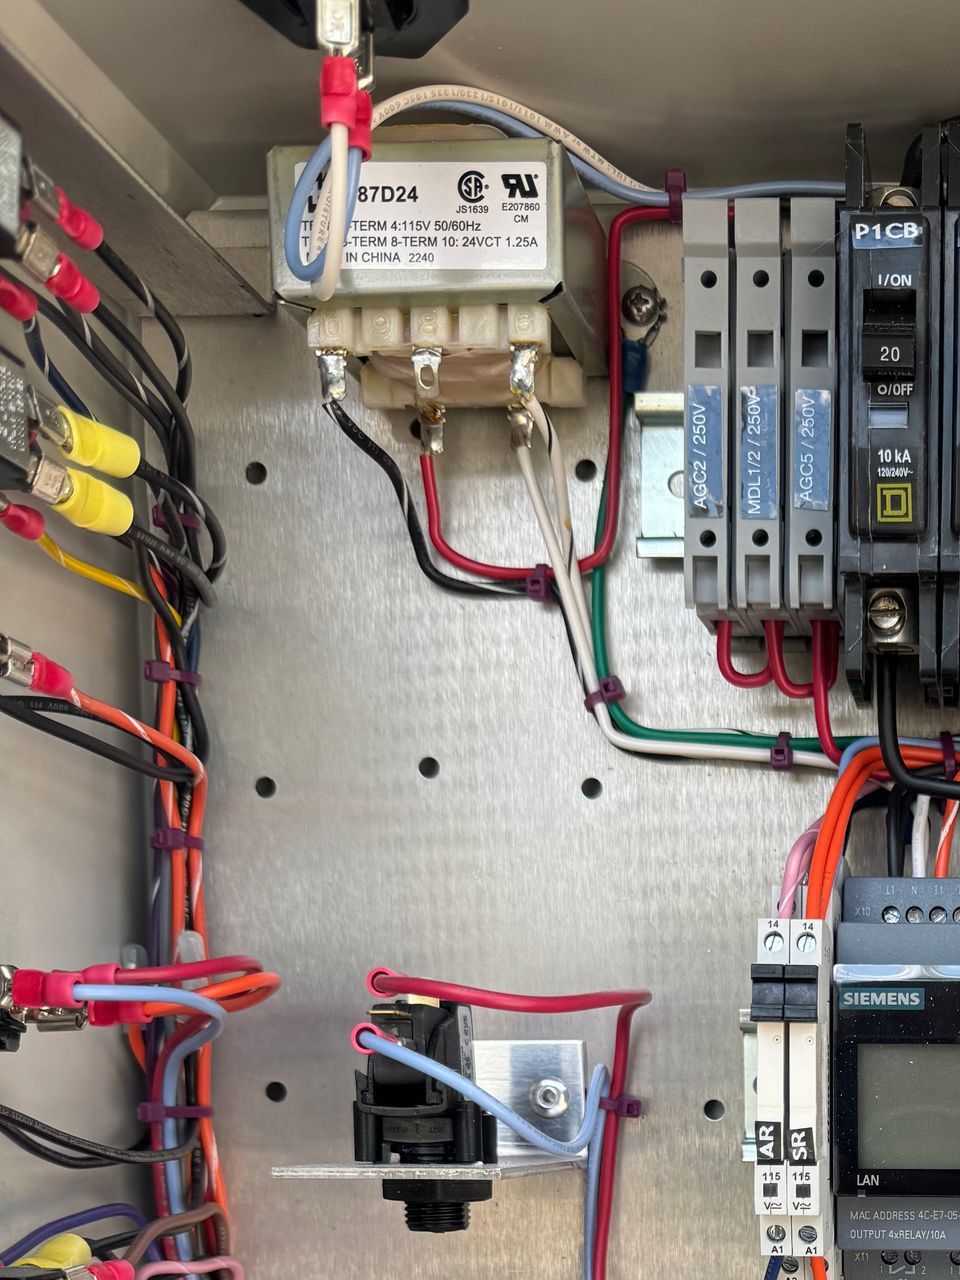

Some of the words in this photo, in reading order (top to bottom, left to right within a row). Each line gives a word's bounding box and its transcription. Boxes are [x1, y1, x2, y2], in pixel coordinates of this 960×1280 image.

[456, 205, 489, 214] JS1639
[502, 202, 540, 211] E207860
[514, 215, 529, 224] CM
[391, 220, 431, 232] 4:115V
[434, 220, 482, 232] 50/60Hz
[855, 222, 919, 239] P1CB
[391, 236, 438, 248] 8-TERM
[441, 236, 459, 248] 10:
[462, 236, 502, 247] 24VCT
[505, 236, 538, 247] 1.25A
[345, 252, 358, 263] IN
[361, 252, 401, 263] CHINA
[408, 252, 435, 263] 2240
[880, 346, 901, 362] 20
[801, 395, 816, 438] 250V
[692, 403, 707, 445] 250V
[877, 449, 892, 463] 10
[894, 448, 911, 463] kA
[748, 452, 761, 514] MDL1/2
[800, 453, 814, 502] AGC5
[693, 461, 708, 510] AGC2
[855, 907, 871, 917] X10
[768, 920, 779, 929] 14
[802, 922, 814, 931] 14
[843, 992, 920, 1006] SIEMENS
[759, 1125, 774, 1159] AR
[790, 1131, 808, 1161] SR
[762, 1172, 781, 1181] 115
[792, 1172, 810, 1181] 115
[856, 1174, 880, 1186] LAN
[850, 1210, 870, 1221] MAC
[873, 1210, 916, 1221] ADDRESS
[850, 1229, 886, 1240] OUTPUT
[771, 1245, 784, 1254] A1
[805, 1246, 817, 1255] A1
